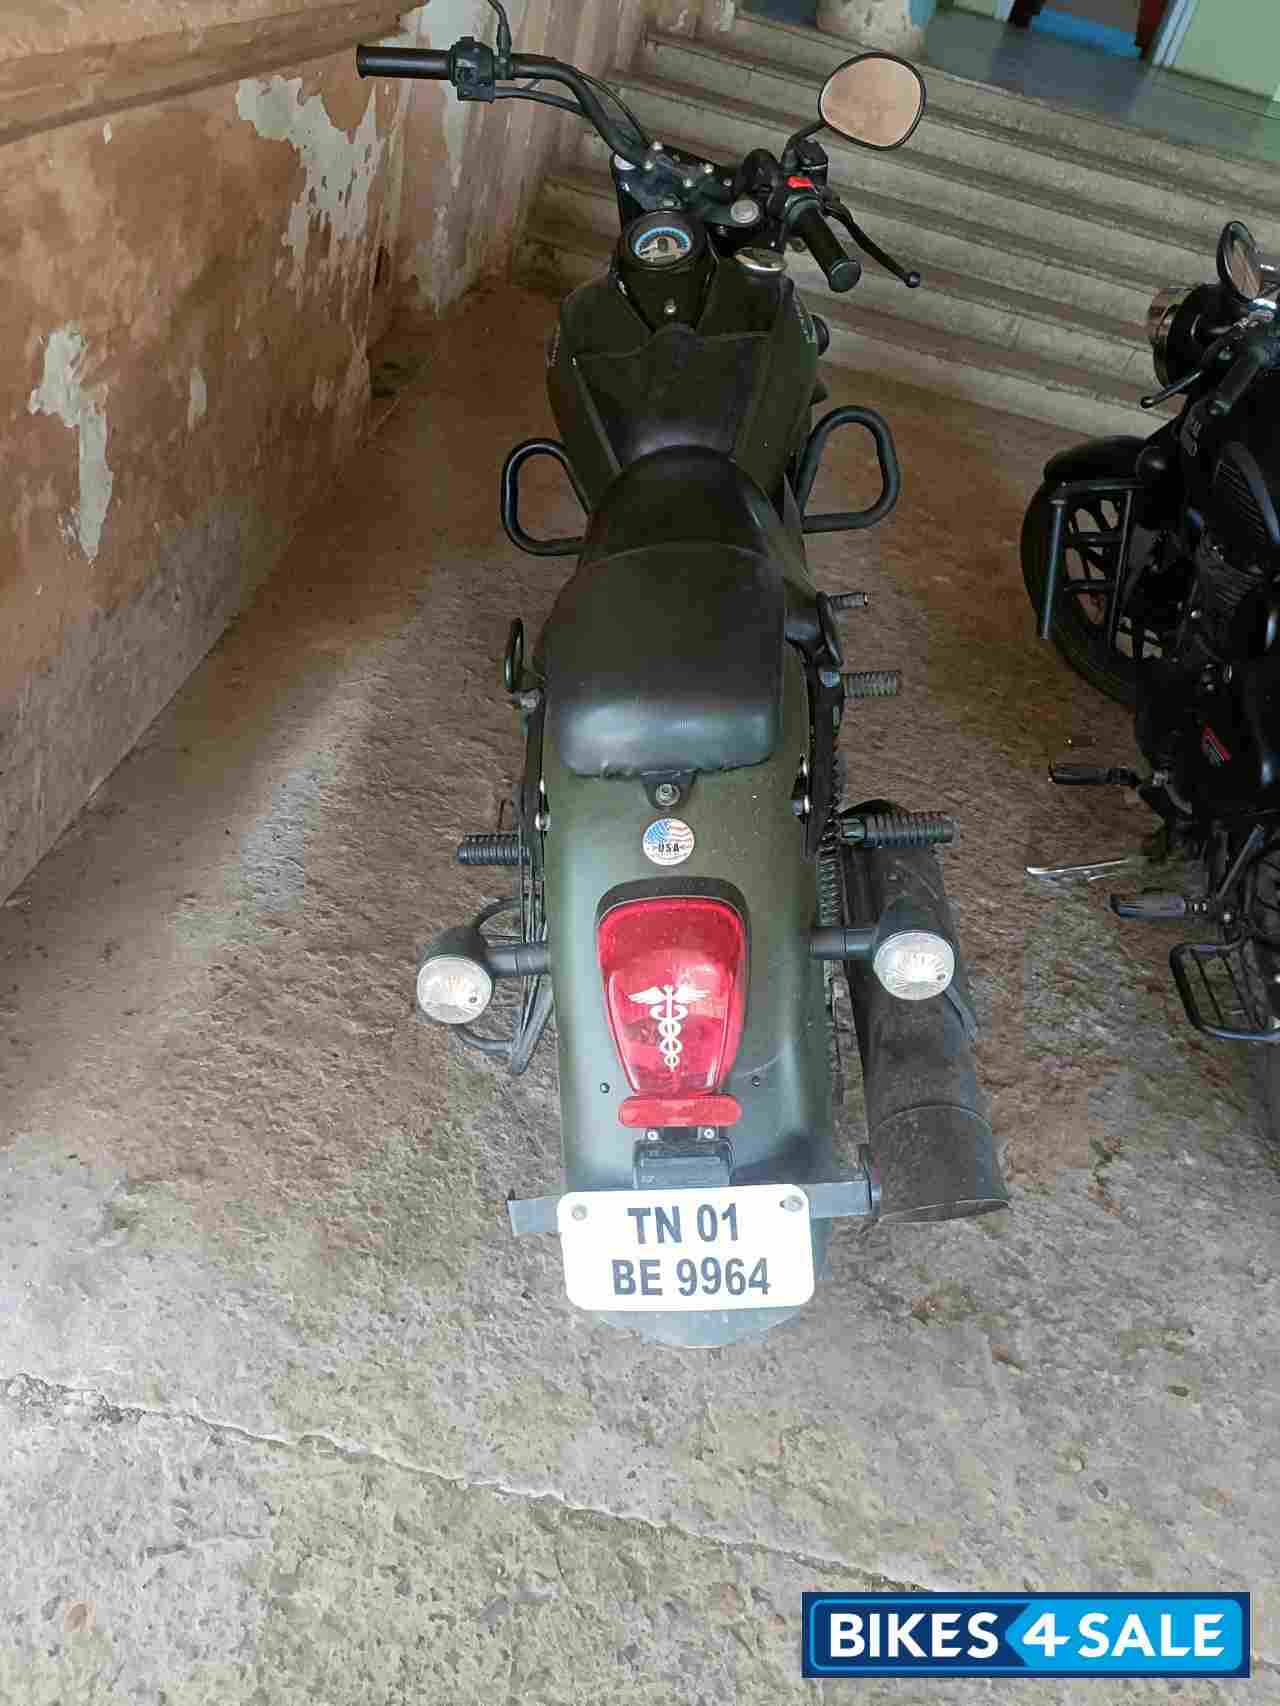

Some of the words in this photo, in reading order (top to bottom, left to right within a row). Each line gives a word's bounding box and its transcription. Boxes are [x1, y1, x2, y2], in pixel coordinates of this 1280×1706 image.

[657, 842, 680, 853] USA
[627, 1205, 683, 1245] TN
[696, 1202, 739, 1243] 01
[611, 1258, 664, 1297] BE
[676, 1256, 772, 1297] 9964
